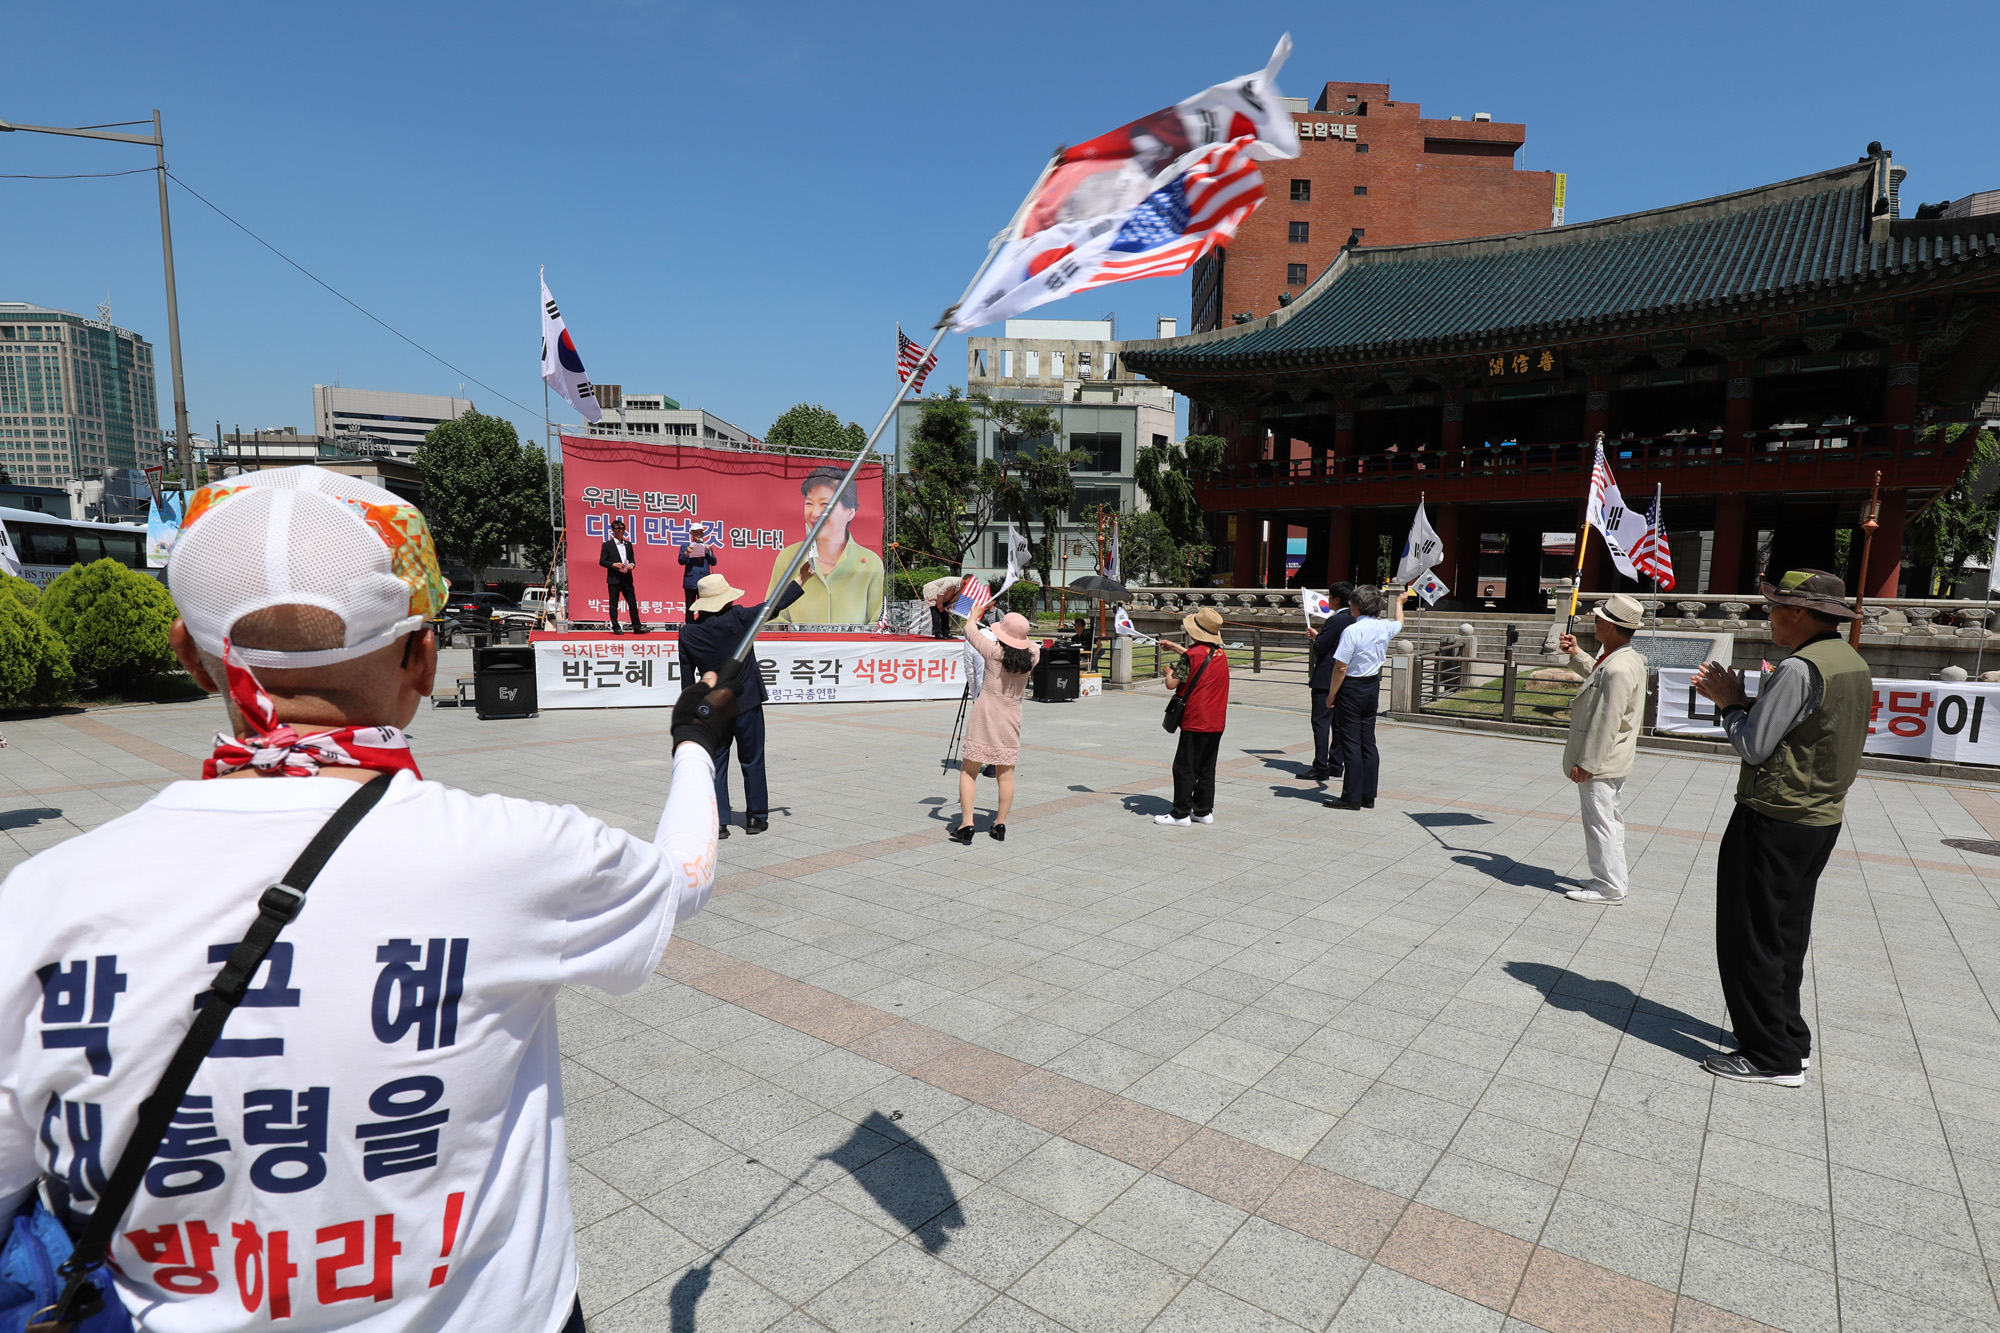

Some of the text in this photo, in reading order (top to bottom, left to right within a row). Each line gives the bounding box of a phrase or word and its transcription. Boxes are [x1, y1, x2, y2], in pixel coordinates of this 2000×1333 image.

[582, 486, 698, 515] 우리는 반드시
[585, 513, 785, 550] 다시 만날 것 입니다!
[24, 569, 37, 579] BS
[561, 643, 680, 659] 억지탄핵 억지구
[562, 659, 653, 689] 박근혜
[790, 658, 843, 685] 즉각
[852, 658, 958, 685] 석방하라!
[110, 1191, 465, 1321] 방하라!
